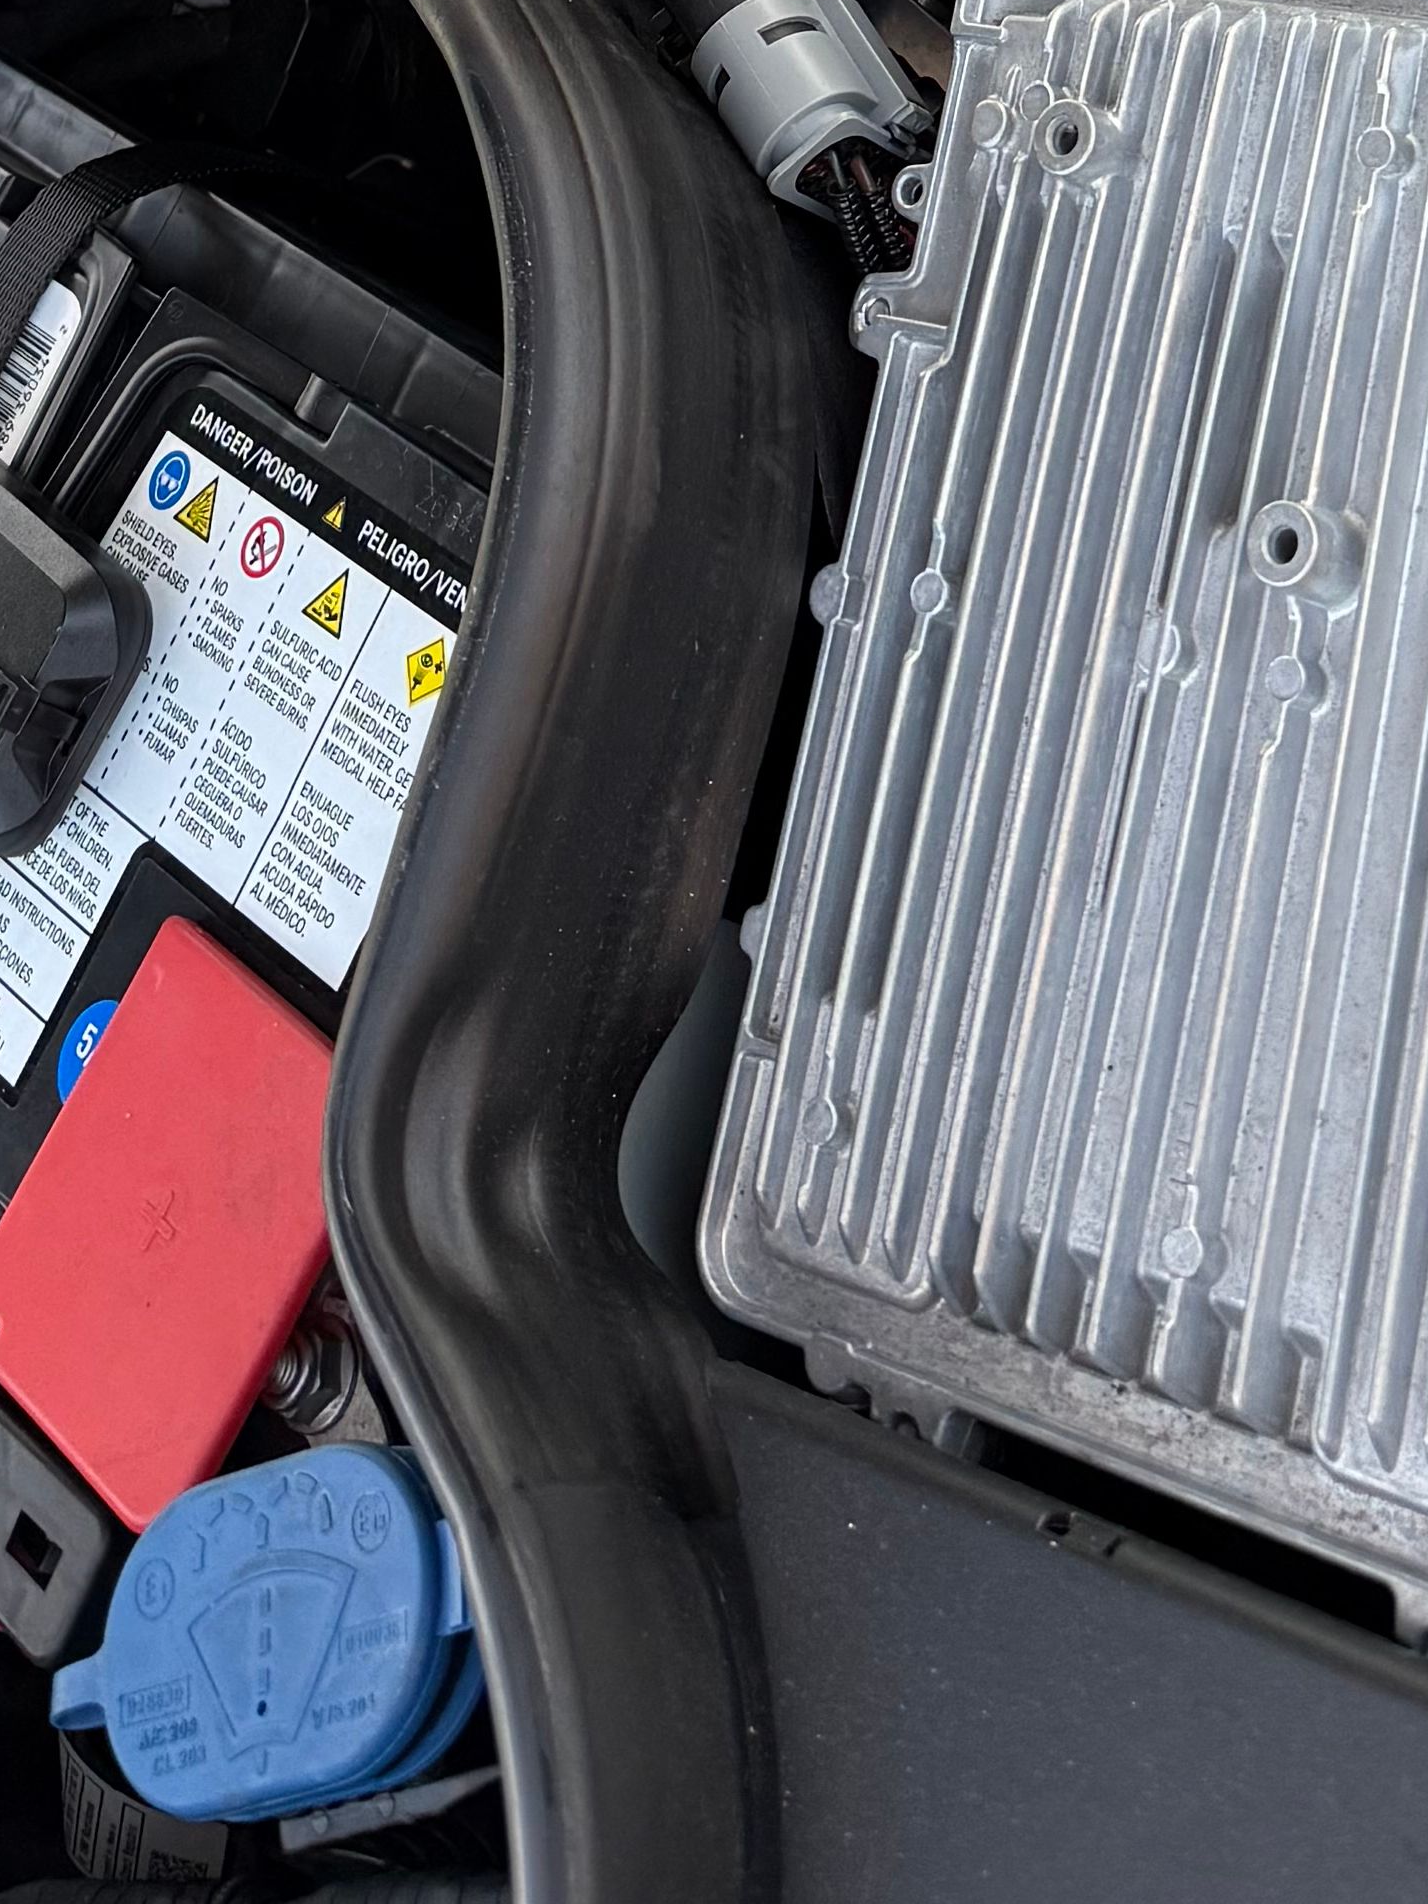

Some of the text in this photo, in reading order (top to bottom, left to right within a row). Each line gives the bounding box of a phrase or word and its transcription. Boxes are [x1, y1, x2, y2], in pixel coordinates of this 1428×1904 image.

[188, 404, 319, 509] DANGER/POISON
[111, 526, 190, 595] EXPLOSIVE GASES
[120, 508, 180, 561] SHIELD EYES.
[209, 575, 230, 598] NO
[356, 519, 471, 617] PELIGRO/VEN
[200, 616, 237, 652] FLAMES
[208, 598, 245, 633] SPARKS
[191, 632, 235, 674] SMOKING
[260, 637, 312, 684] CAN CAUSE
[268, 618, 344, 684] SULFURIC ACID
[161, 671, 180, 695] NO
[242, 672, 311, 733] SEVERE BURNS.
[251, 655, 317, 713] BLINDNESS OR
[349, 678, 412, 735] FLUSH EYES
[151, 713, 190, 751] LLAMAS
[160, 696, 200, 735] CHISPAS
[219, 713, 256, 753] ÁCIDO
[339, 698, 409, 759] IMMEDIATELY
[142, 730, 176, 765] FUMAR
[210, 734, 269, 791] SULFÚRICO
[329, 717, 360, 750] WITH
[355, 737, 397, 778] WATER.
[192, 773, 243, 822] CEGUERA O
[201, 756, 268, 818] PUEDE CAUSAR
[319, 738, 408, 815] MEDICAL HELP FA
[73, 800, 91, 823] OF
[87, 811, 109, 838] THE
[173, 807, 217, 851] FUERTES.
[182, 790, 247, 850] QUEMADURAS
[289, 800, 340, 850] LOS OJOS
[298, 780, 354, 834] ENJUAGUE
[55, 847, 86, 883] FUERA
[81, 870, 104, 898] DEL
[64, 820, 116, 872] CHILDREN.
[268, 839, 328, 896] CON AGUA.
[279, 819, 366, 897] INMEDIATAMENTE
[36, 858, 54, 882] DE
[48, 869, 70, 897] LOS
[64, 880, 101, 923] NIÑOS.
[249, 879, 312, 939] AL MÉDICO.
[259, 859, 337, 931] ACUDA RÁPIDO
[7, 887, 78, 959] INSTRUCTIONS.
